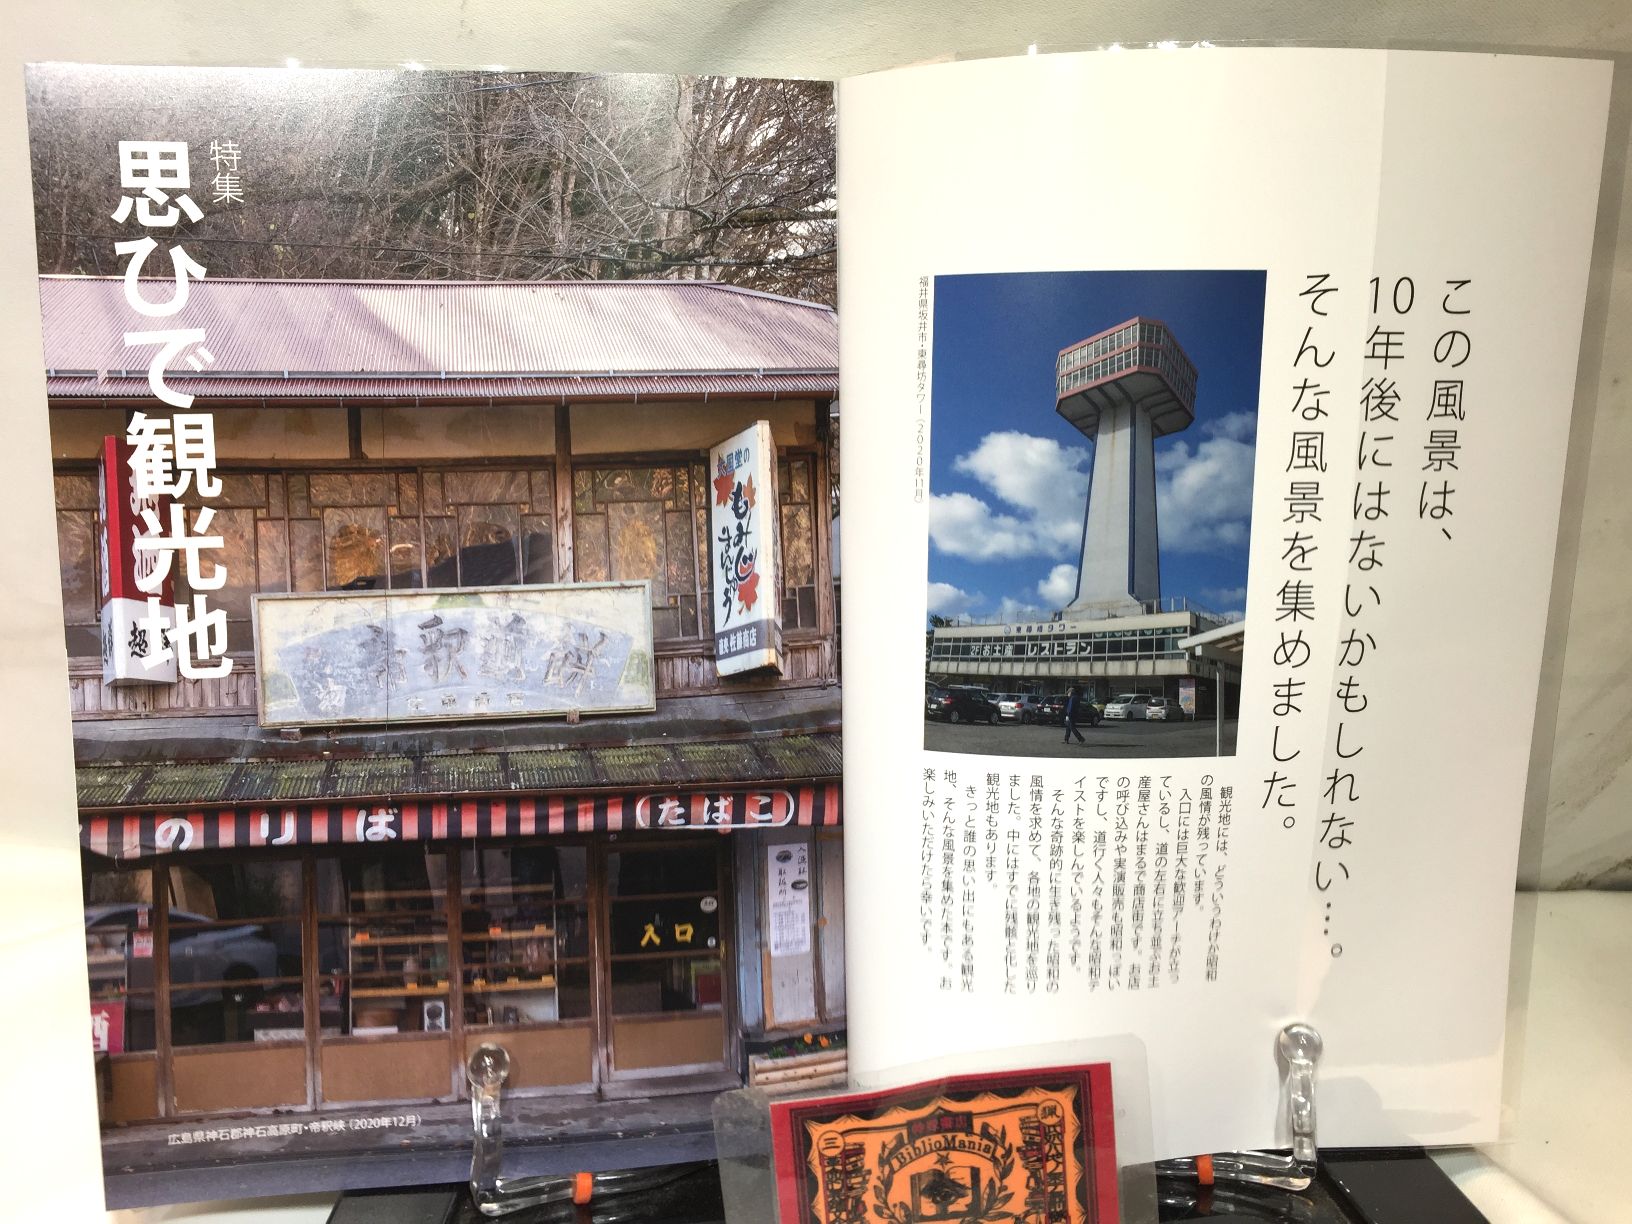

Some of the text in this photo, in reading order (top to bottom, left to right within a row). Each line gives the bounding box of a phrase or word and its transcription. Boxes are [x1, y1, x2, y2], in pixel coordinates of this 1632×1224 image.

[208, 140, 245, 204] 特集
[110, 140, 233, 679] 思ひで観光地
[1420, 280, 1471, 540] この風景は、
[1262, 274, 1338, 829] そんな風景を集めました。
[1027, 640, 1091, 656] レストラン
[658, 794, 774, 826] たばこ
[640, 922, 694, 948] 入口
[895, 1134, 993, 1165] BiblioMania
